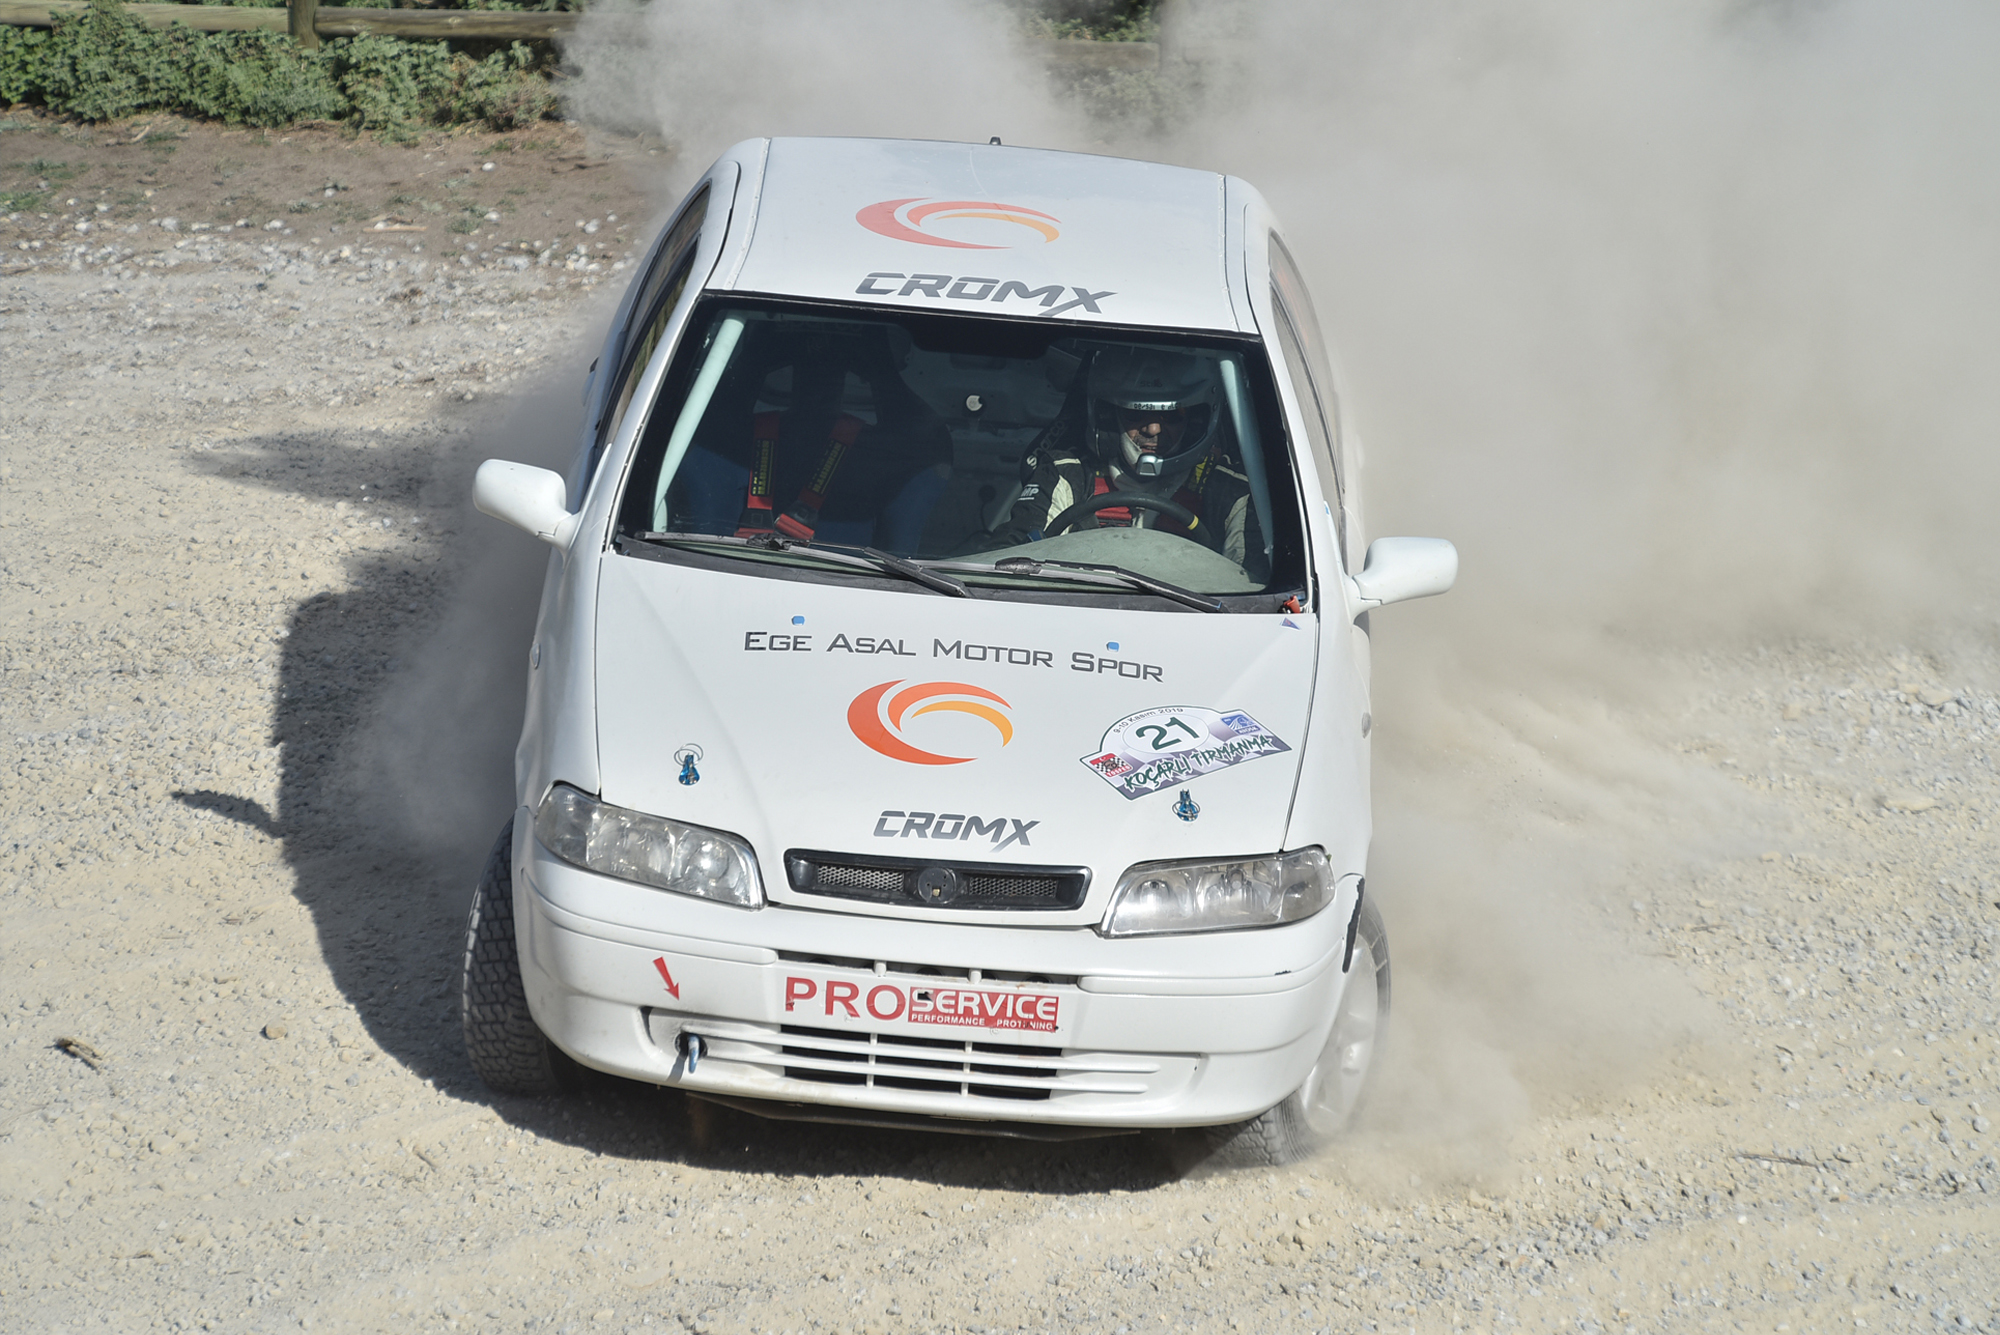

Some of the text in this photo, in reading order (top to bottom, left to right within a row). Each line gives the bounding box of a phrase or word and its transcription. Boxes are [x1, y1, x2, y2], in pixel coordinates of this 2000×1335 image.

[855, 272, 1118, 317] CROMX
[744, 631, 1164, 683] EGE ASAL MOTOR SPOR
[1135, 716, 1200, 751] 21
[1124, 734, 1273, 787] KOÇARLI TIRMANMA
[873, 810, 1041, 853] CROMX
[785, 976, 1057, 1021] PRO SERVICE
[911, 1013, 985, 1026] PERFORMANCE
